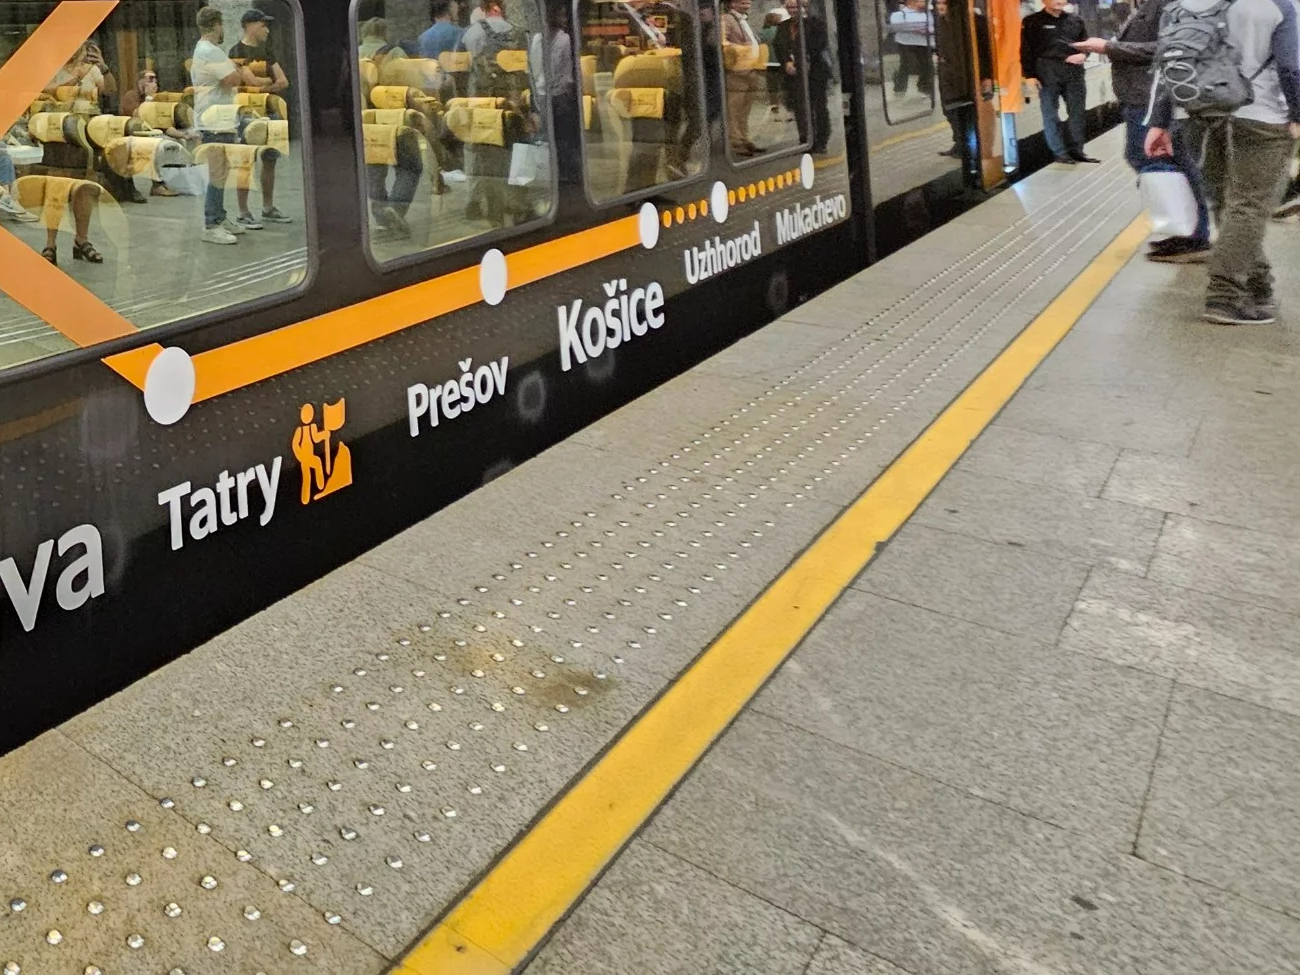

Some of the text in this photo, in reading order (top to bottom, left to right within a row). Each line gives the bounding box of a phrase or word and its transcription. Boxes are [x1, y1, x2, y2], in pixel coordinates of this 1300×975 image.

[684, 221, 762, 285] Uzhhorod
[775, 193, 848, 246] Mukachevo
[557, 278, 666, 372] Košice
[406, 356, 509, 438] Prešov
[157, 455, 284, 552] Tatry
